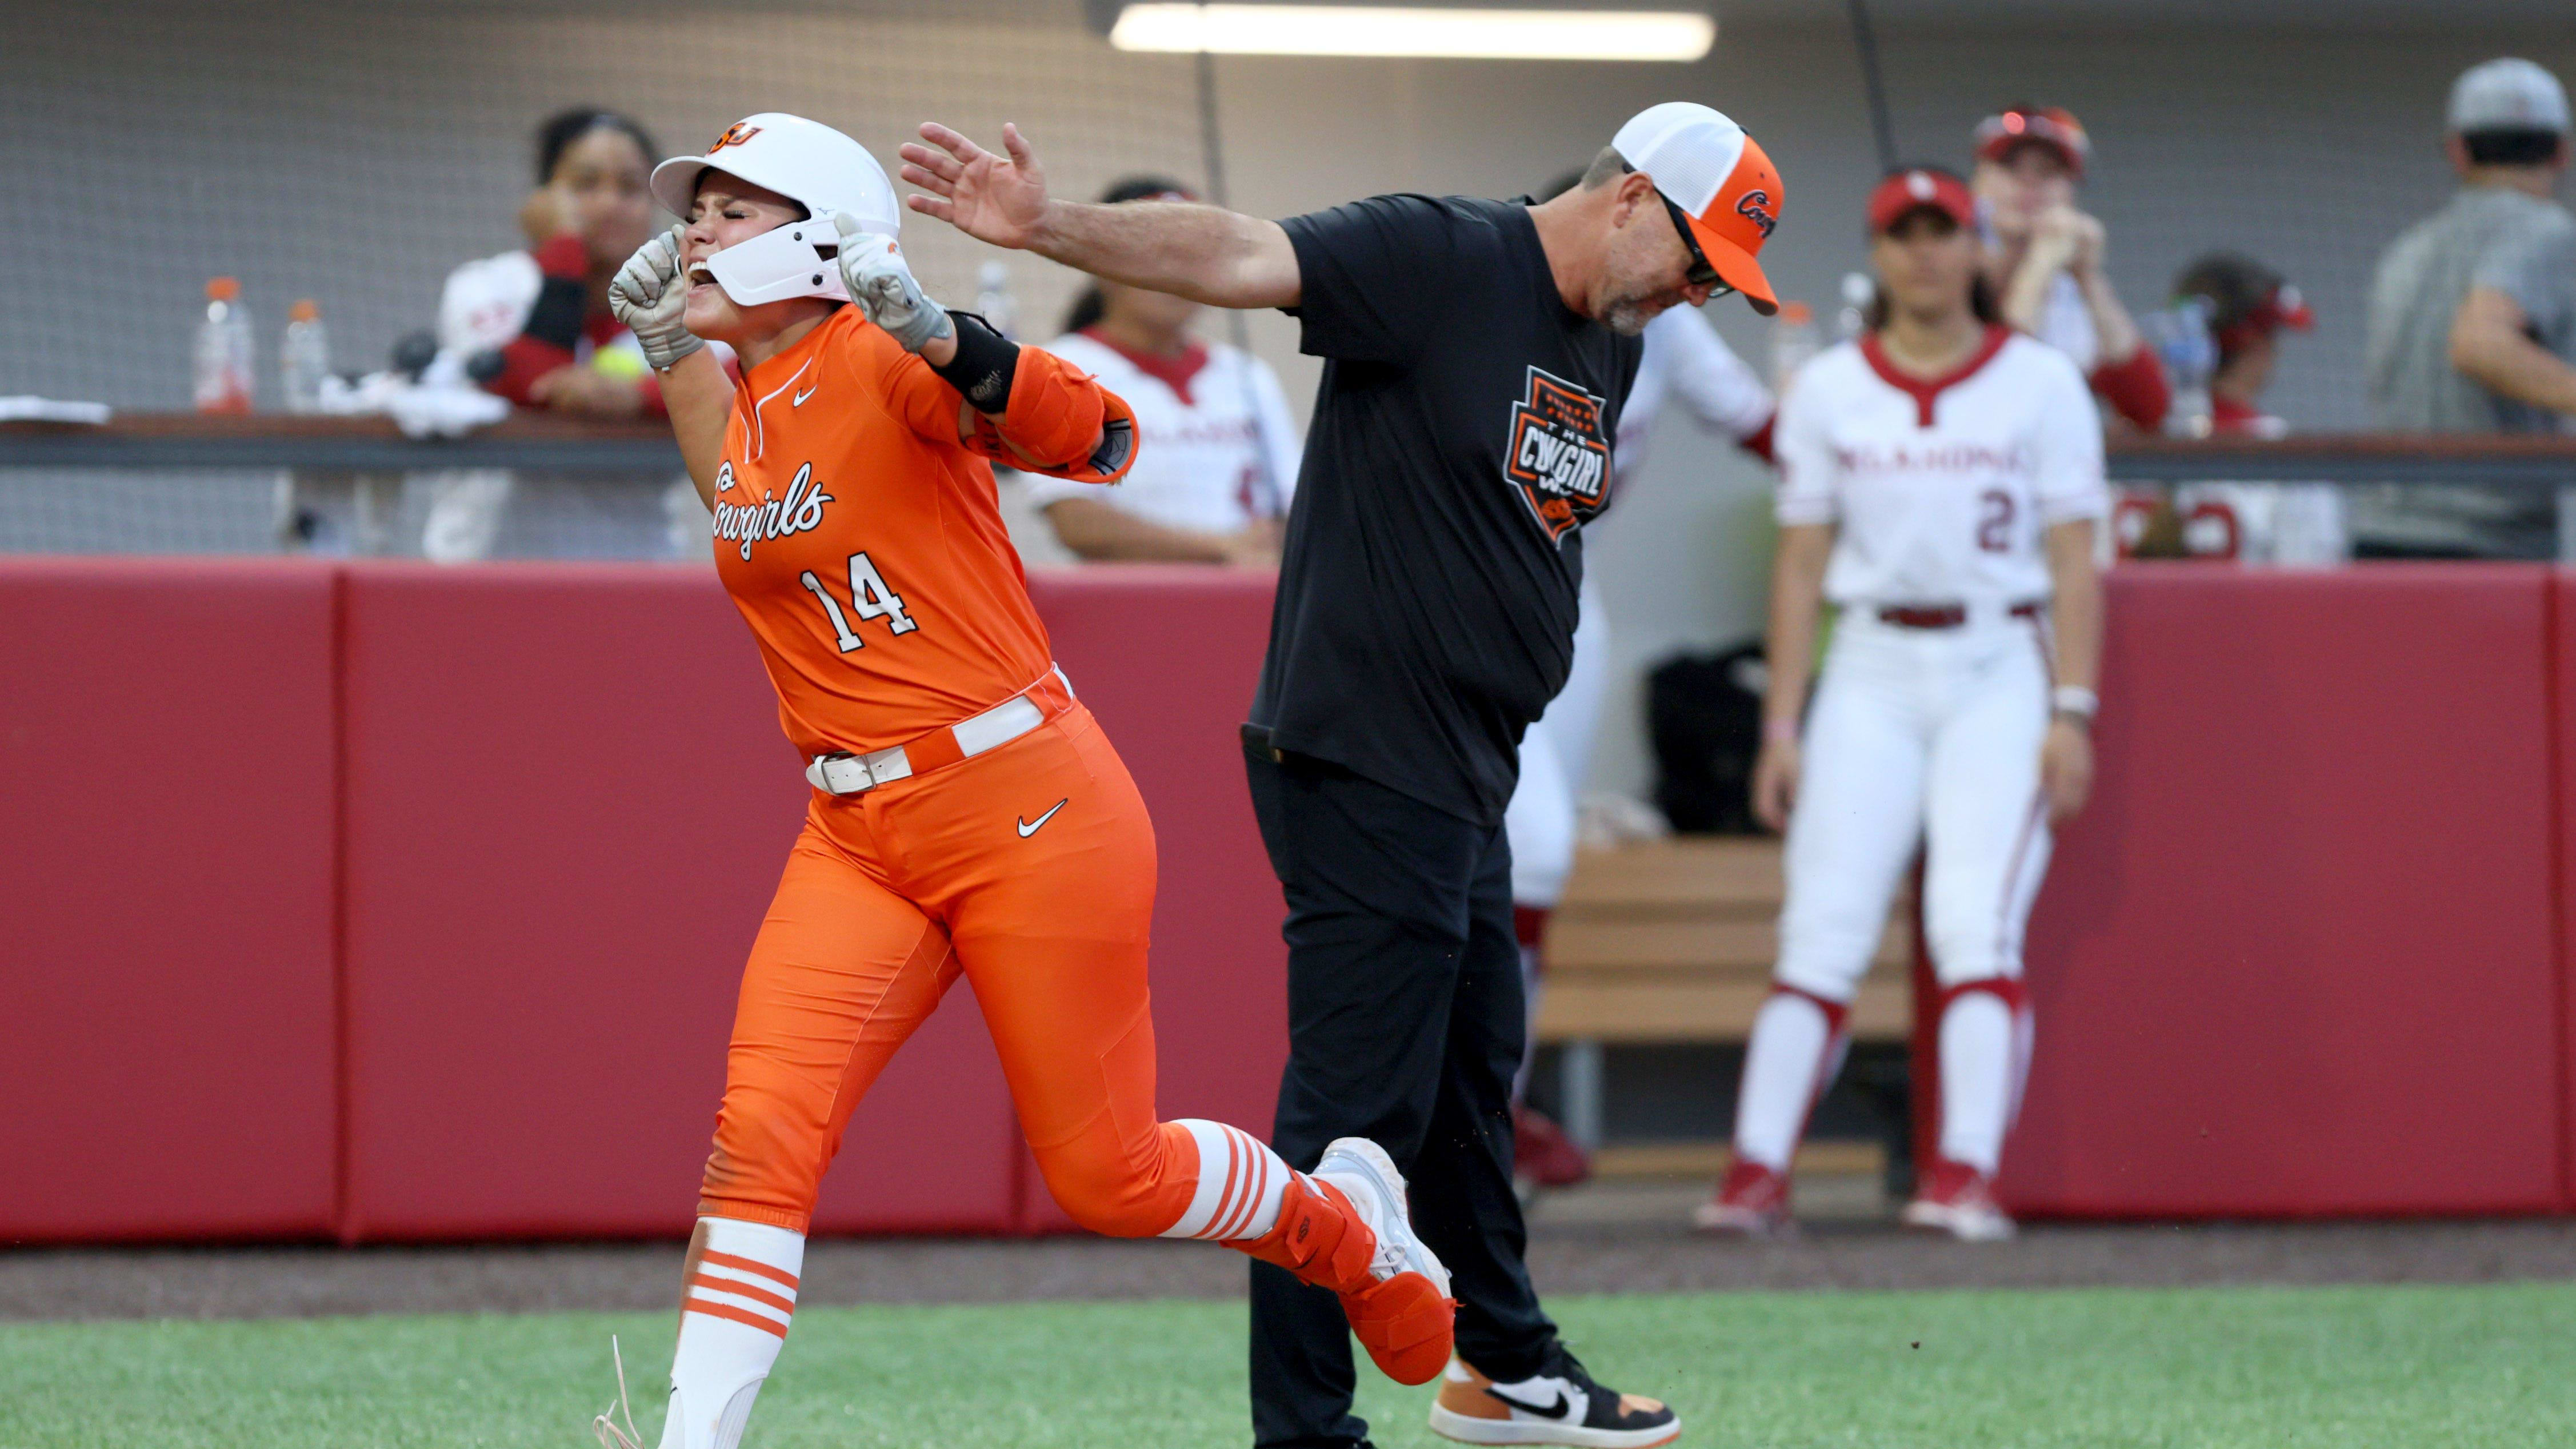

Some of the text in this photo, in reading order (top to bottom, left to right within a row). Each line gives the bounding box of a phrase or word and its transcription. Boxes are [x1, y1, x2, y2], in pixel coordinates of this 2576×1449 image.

[1547, 421, 1586, 446] THE
[713, 461, 835, 562] owgirls
[1976, 488, 2015, 552] 2
[799, 550, 920, 654] 14
